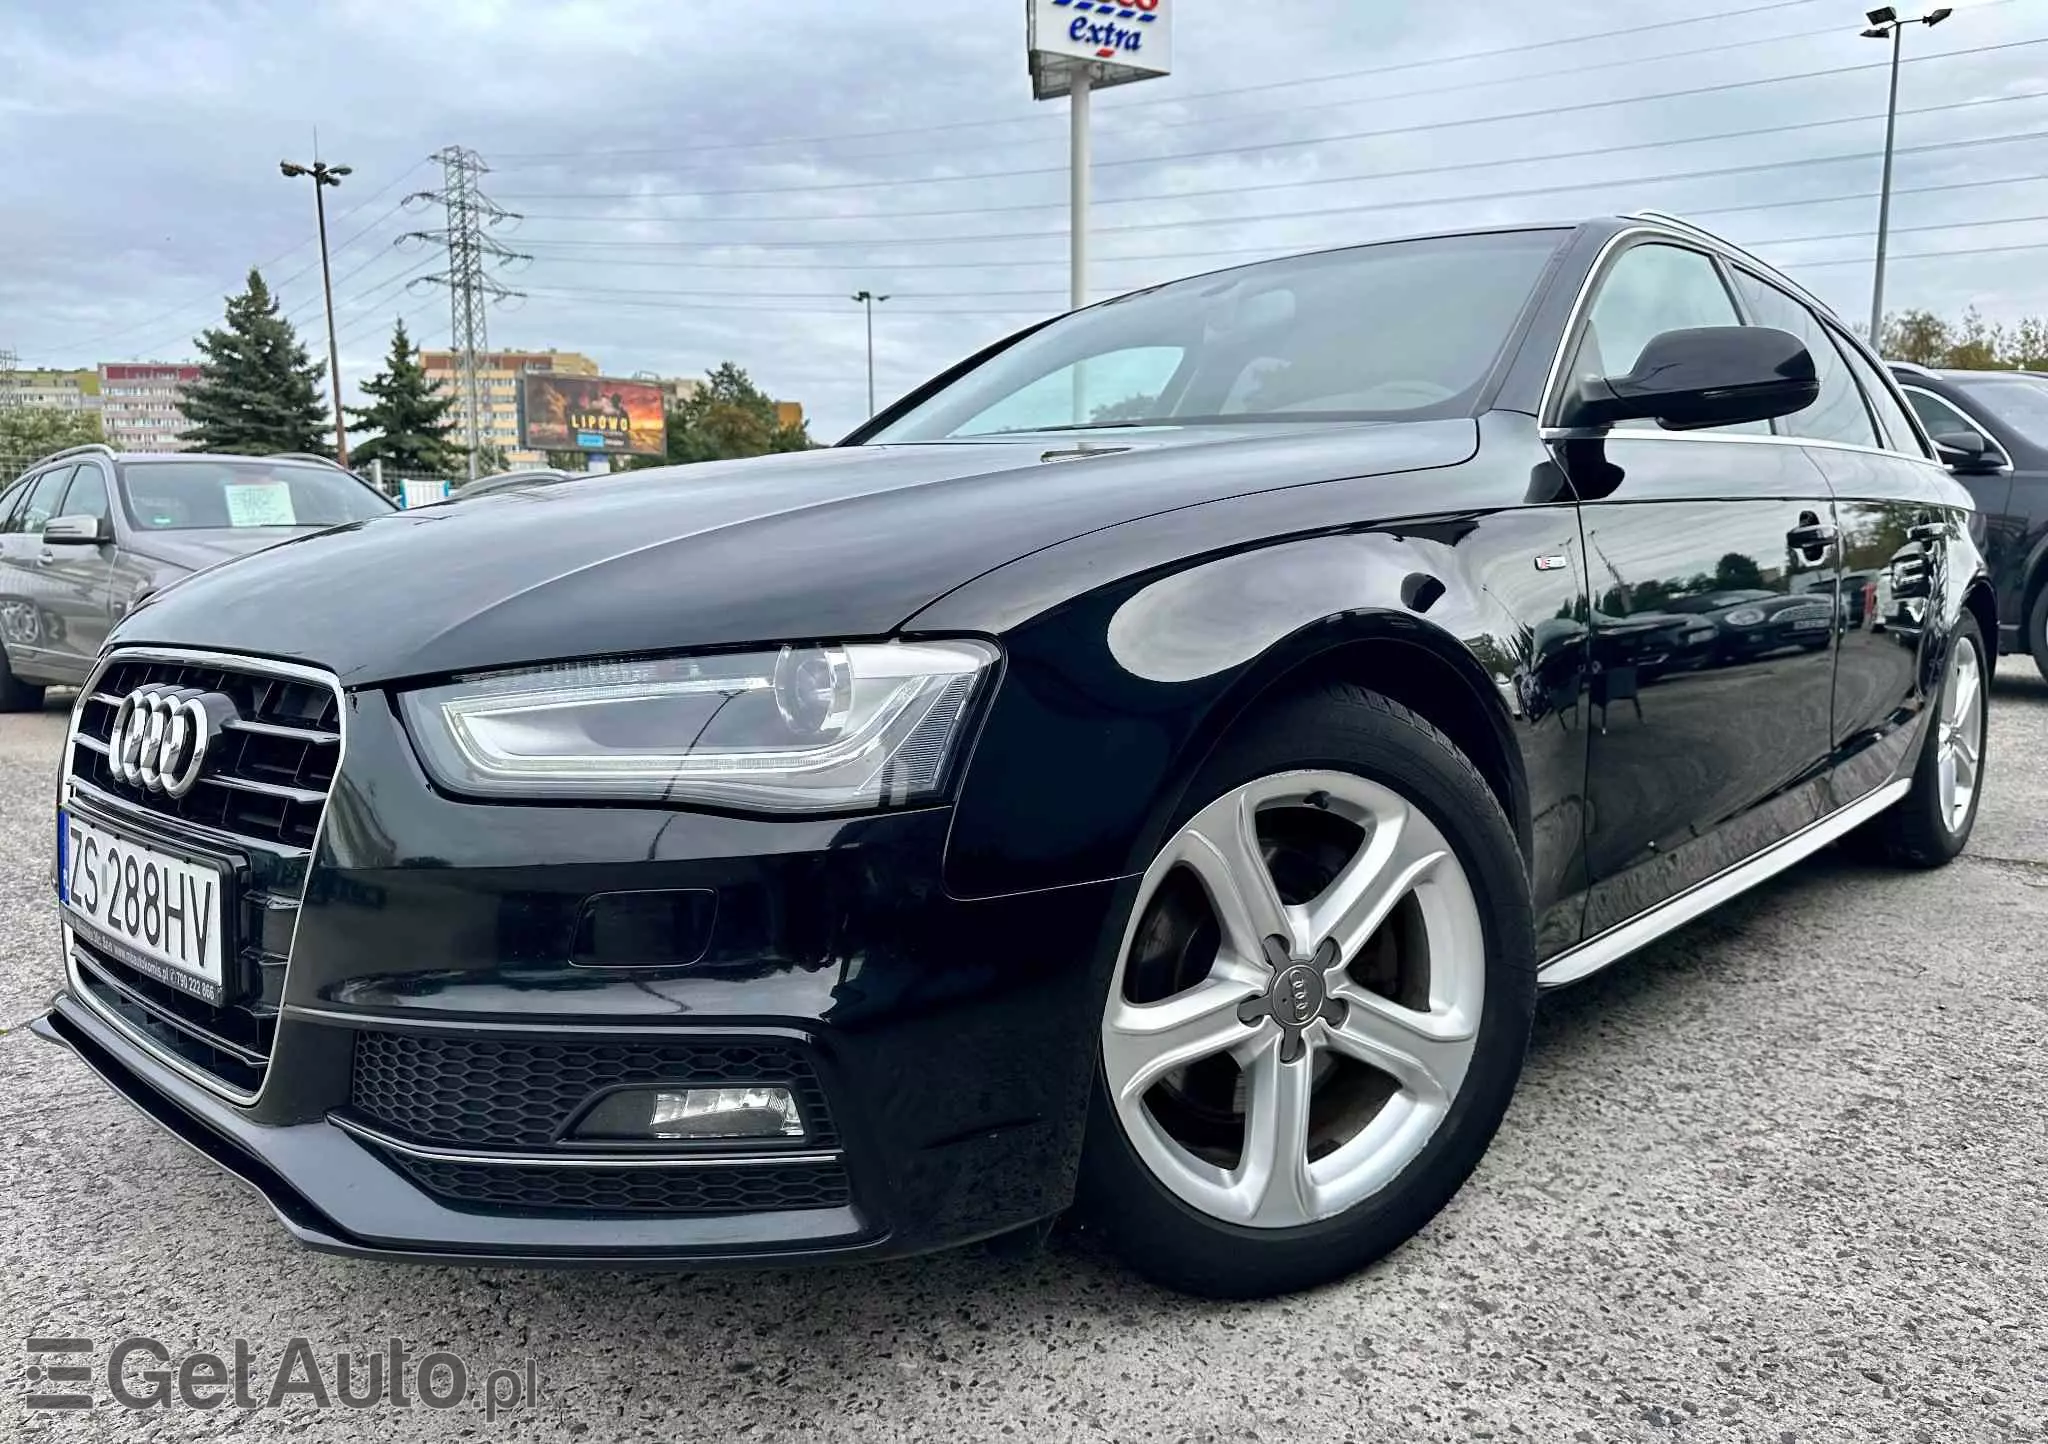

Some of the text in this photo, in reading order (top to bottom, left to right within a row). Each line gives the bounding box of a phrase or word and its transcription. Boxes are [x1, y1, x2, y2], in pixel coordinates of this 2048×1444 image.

[1069, 16, 1142, 51] extra
[571, 414, 628, 431] LIPOWO
[70, 826, 98, 914] ZS
[107, 847, 212, 967] 288HV
[176, 971, 188, 989] 790
[188, 976, 201, 995] 222
